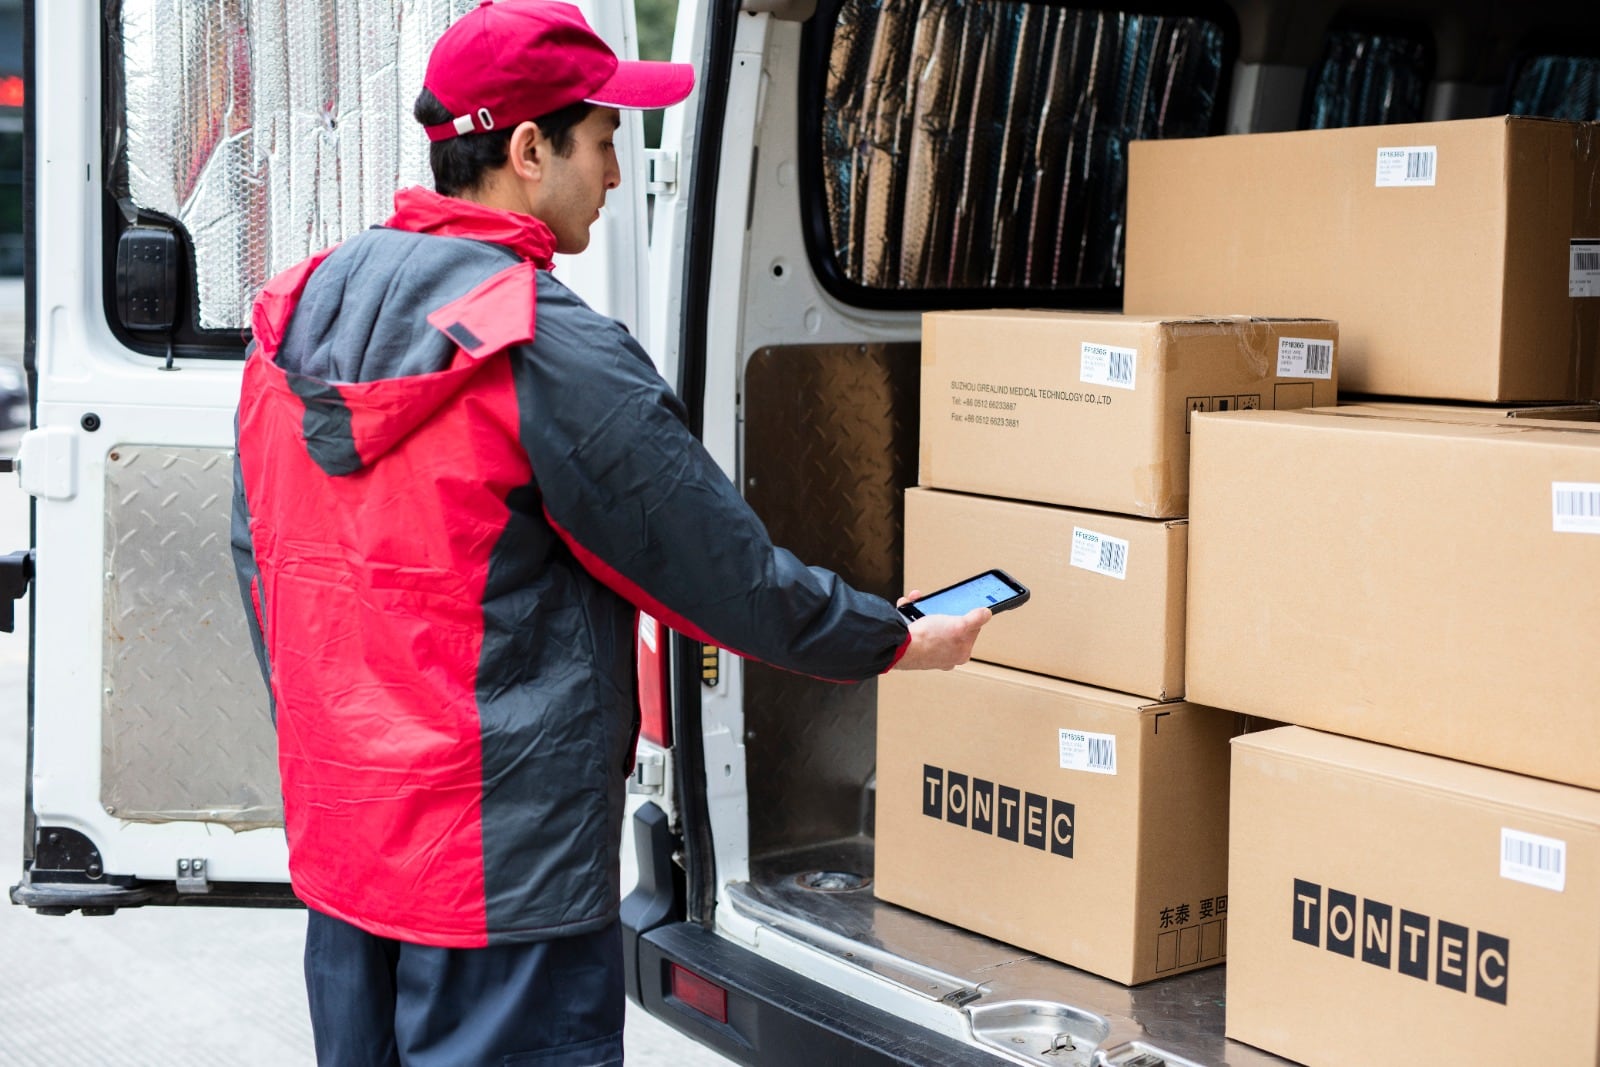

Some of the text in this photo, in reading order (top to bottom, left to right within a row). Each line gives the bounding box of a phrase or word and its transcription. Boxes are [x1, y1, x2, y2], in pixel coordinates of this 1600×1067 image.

[963, 398, 974, 407] +86
[974, 398, 988, 409] 0512
[1009, 386, 1038, 398] MEDICAL
[1038, 389, 1084, 402] TECHNOLOGY
[964, 414, 975, 424] +86
[975, 415, 989, 425] 0512
[925, 775, 1073, 847] TONTEC
[1159, 903, 1190, 929] 东泰
[1297, 892, 1506, 990] TONTEC
